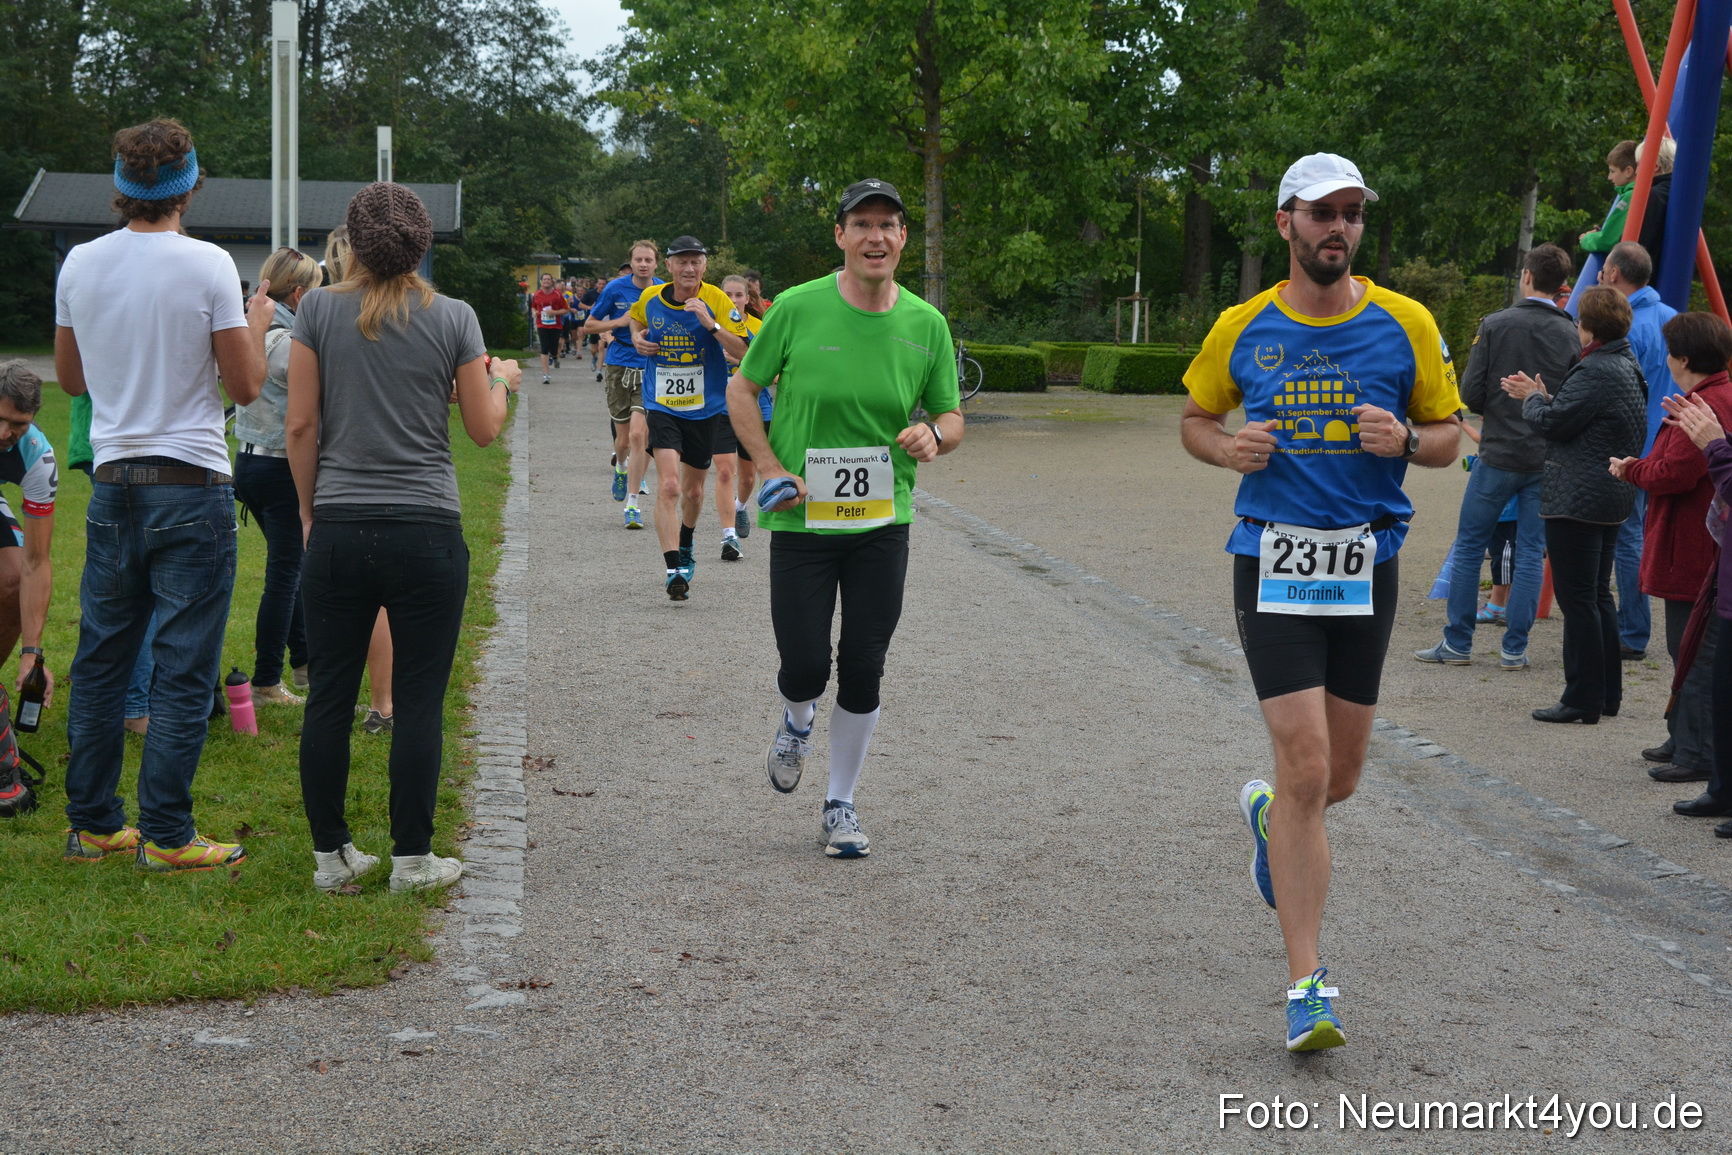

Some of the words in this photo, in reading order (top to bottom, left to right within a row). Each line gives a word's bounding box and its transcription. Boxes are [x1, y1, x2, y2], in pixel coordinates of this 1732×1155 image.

[1261, 352, 1278, 361] Jahre
[666, 378, 695, 394] 284
[1277, 408, 1333, 417] 21.September
[1335, 408, 1355, 416] 2014
[807, 456, 837, 464] PARTL
[839, 455, 878, 464] Neumarkt
[113, 468, 159, 482] PMA
[834, 467, 870, 497] 28
[836, 505, 866, 517] Peter
[1272, 537, 1366, 576] 2316
[1287, 585, 1345, 600] Dominik
